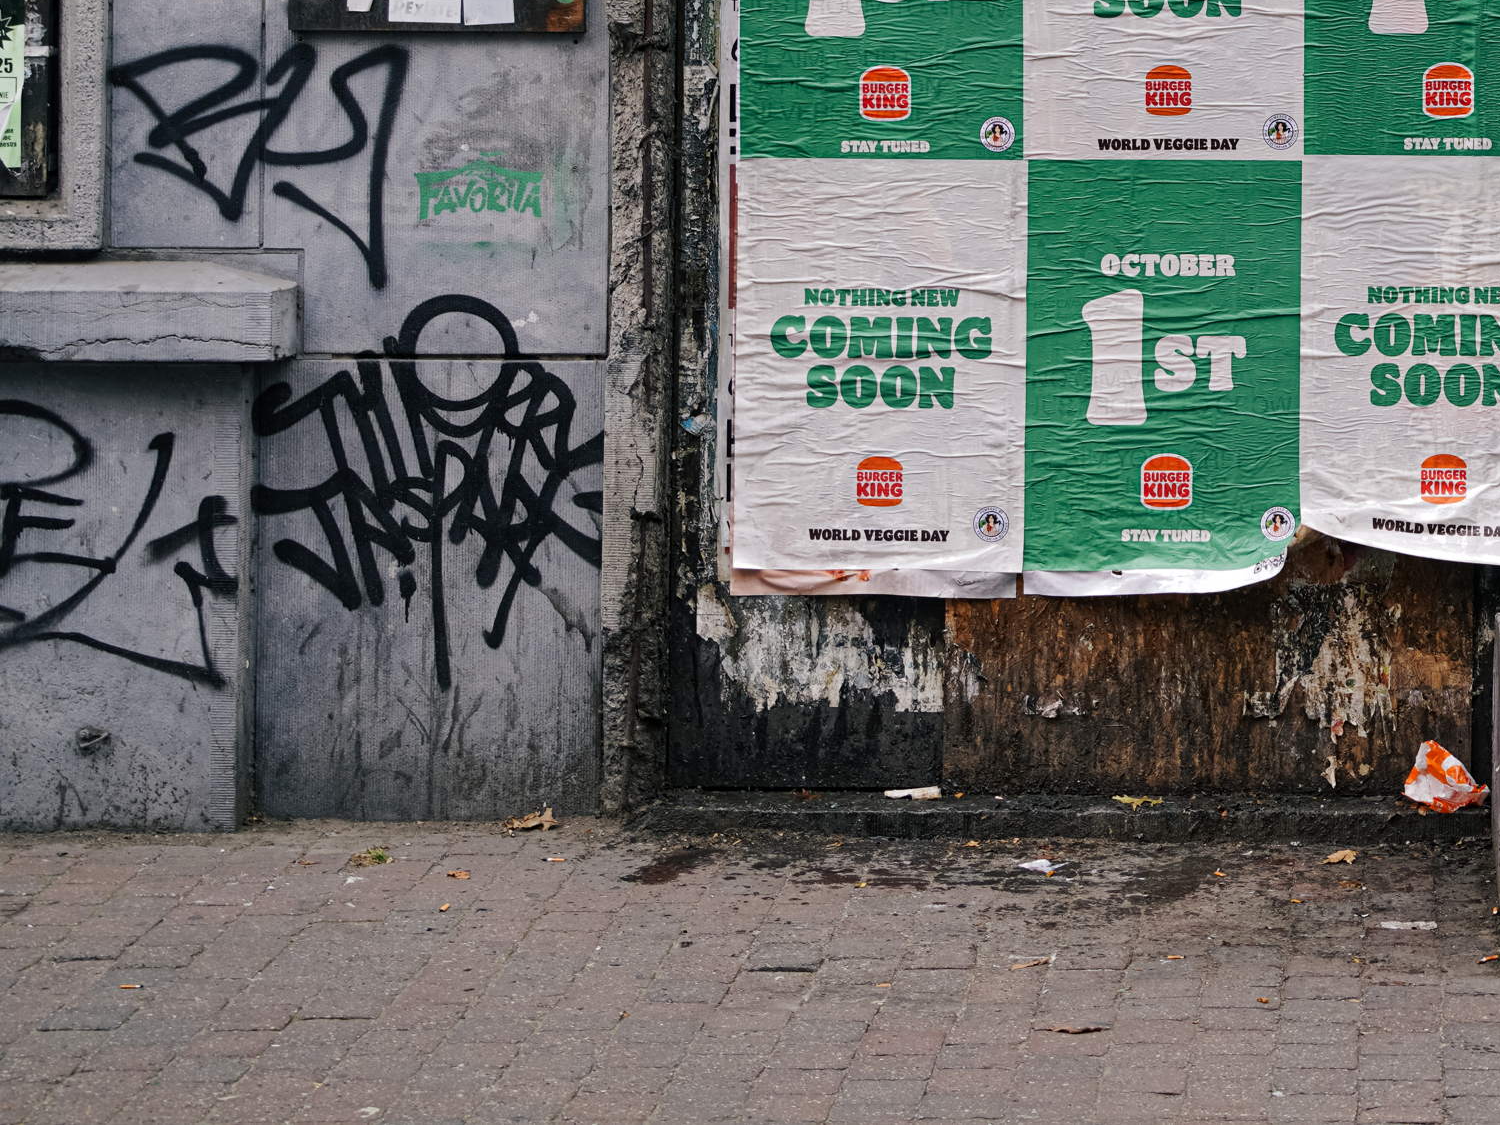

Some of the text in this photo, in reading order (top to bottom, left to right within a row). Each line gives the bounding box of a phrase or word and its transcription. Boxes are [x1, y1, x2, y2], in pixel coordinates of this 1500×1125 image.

[862, 83, 909, 95] BURGER
[1146, 80, 1191, 92] BURGER
[1426, 81, 1472, 93] BURGER
[862, 94, 909, 110] KING
[1146, 92, 1191, 107] KING
[1426, 91, 1472, 107] KING
[840, 140, 929, 153] STAY TUNED
[1098, 138, 1239, 152] WORLD VEGGIE DAY
[1404, 138, 1492, 151] STAY TUNED
[1101, 254, 1236, 277] OCTOBER
[805, 288, 960, 307] NOTHING NEW
[1368, 287, 1470, 305] NOTHING
[771, 315, 992, 359] COMING
[807, 365, 955, 409] SOON
[856, 472, 903, 483] BURGER
[1144, 471, 1190, 484] BURGER
[1420, 469, 1467, 482] BURGER
[856, 482, 903, 498] KING
[1144, 483, 1190, 498] KING
[1420, 481, 1467, 496] KING
[1372, 517, 1423, 534] WORLD
[1427, 521, 1480, 537] VEGGIE
[809, 529, 949, 542] WORLD VEGGIE DAY
[1121, 529, 1211, 542] STAY TUNED
